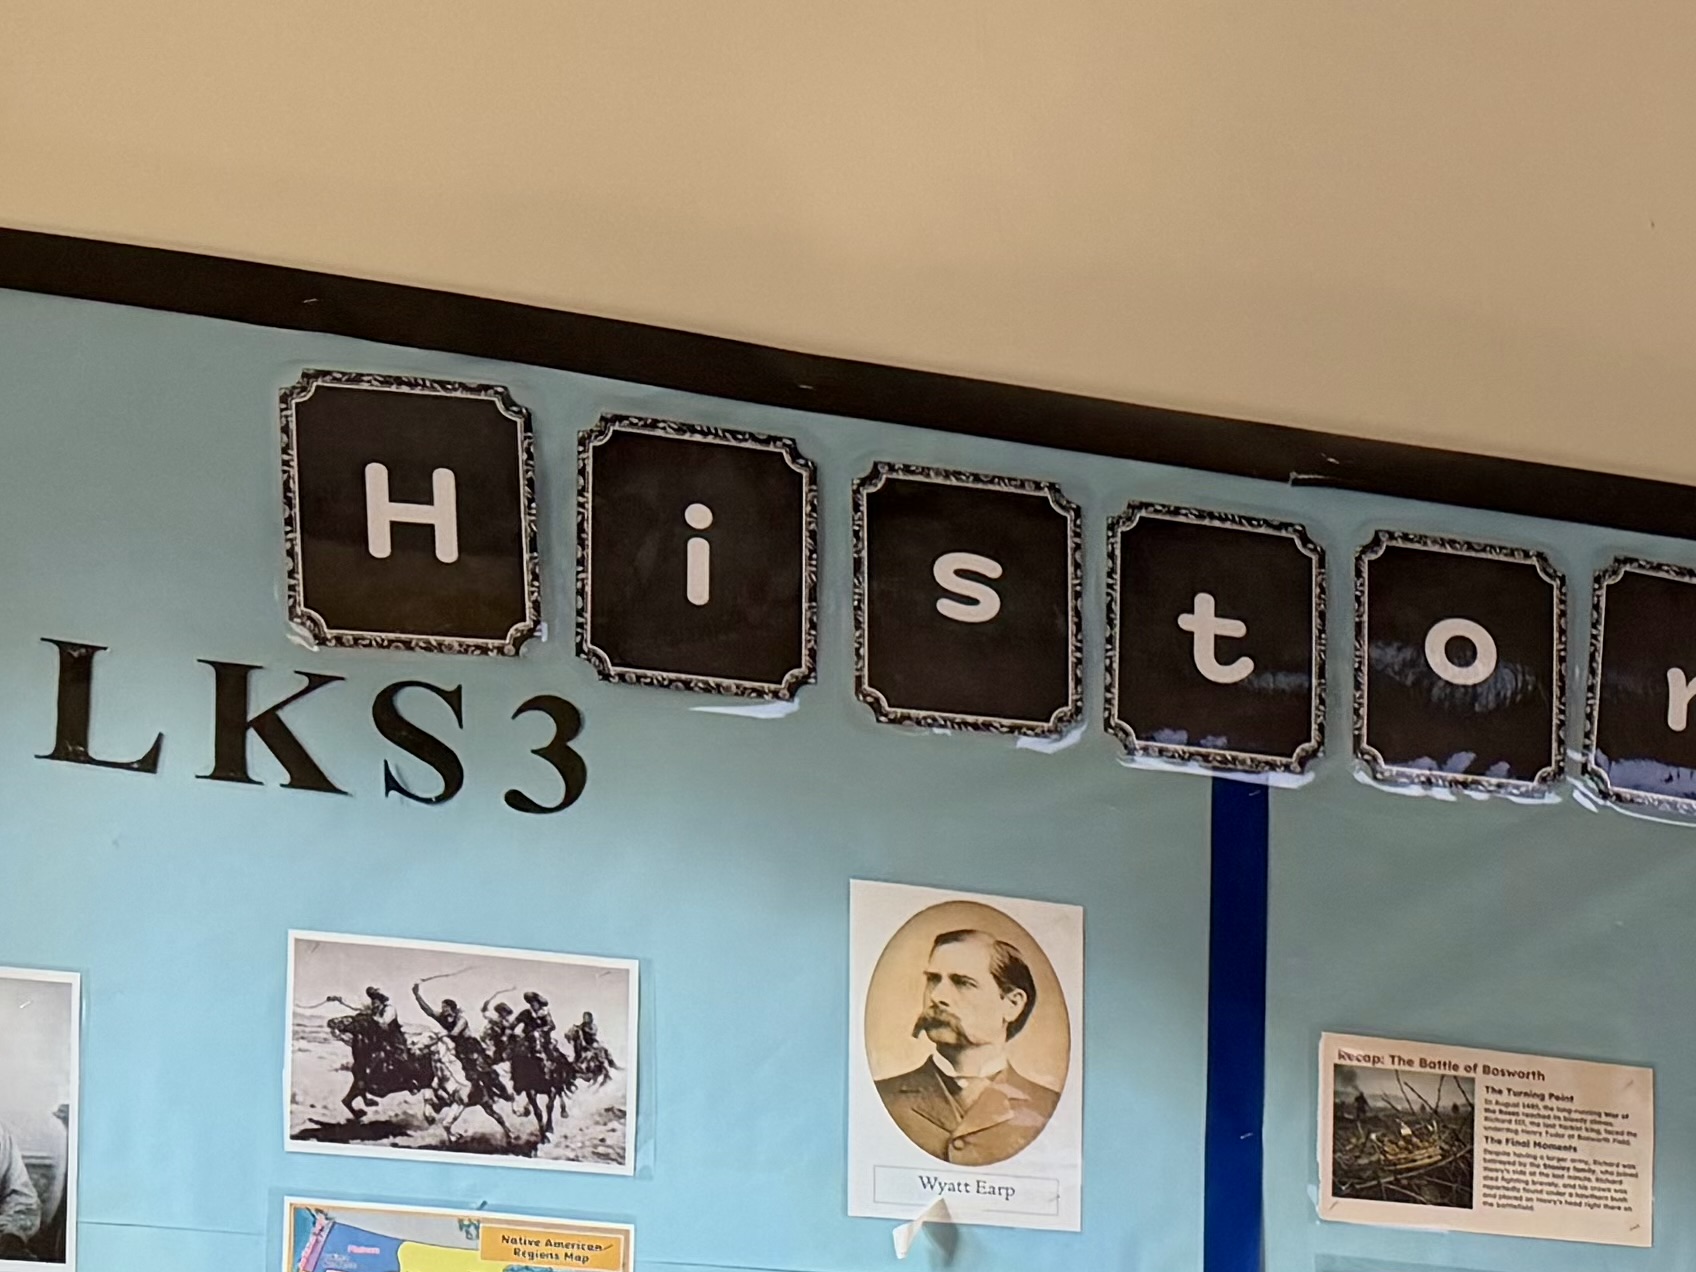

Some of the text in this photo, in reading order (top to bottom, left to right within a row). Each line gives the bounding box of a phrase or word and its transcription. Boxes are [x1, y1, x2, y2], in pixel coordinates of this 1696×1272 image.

[34, 637, 587, 814] LKS3
[1390, 1054, 1414, 1067] The
[1419, 1057, 1460, 1073] Battle
[1464, 1062, 1478, 1074] of
[1482, 1064, 1546, 1082] Bosworth
[1485, 1086, 1574, 1102] The Turning Point
[1484, 1136, 1577, 1152] The Final Moments
[918, 1176, 1015, 1200] Wyatt Earp
[501, 1234, 603, 1252] Native American
[564, 1251, 590, 1264] Map
